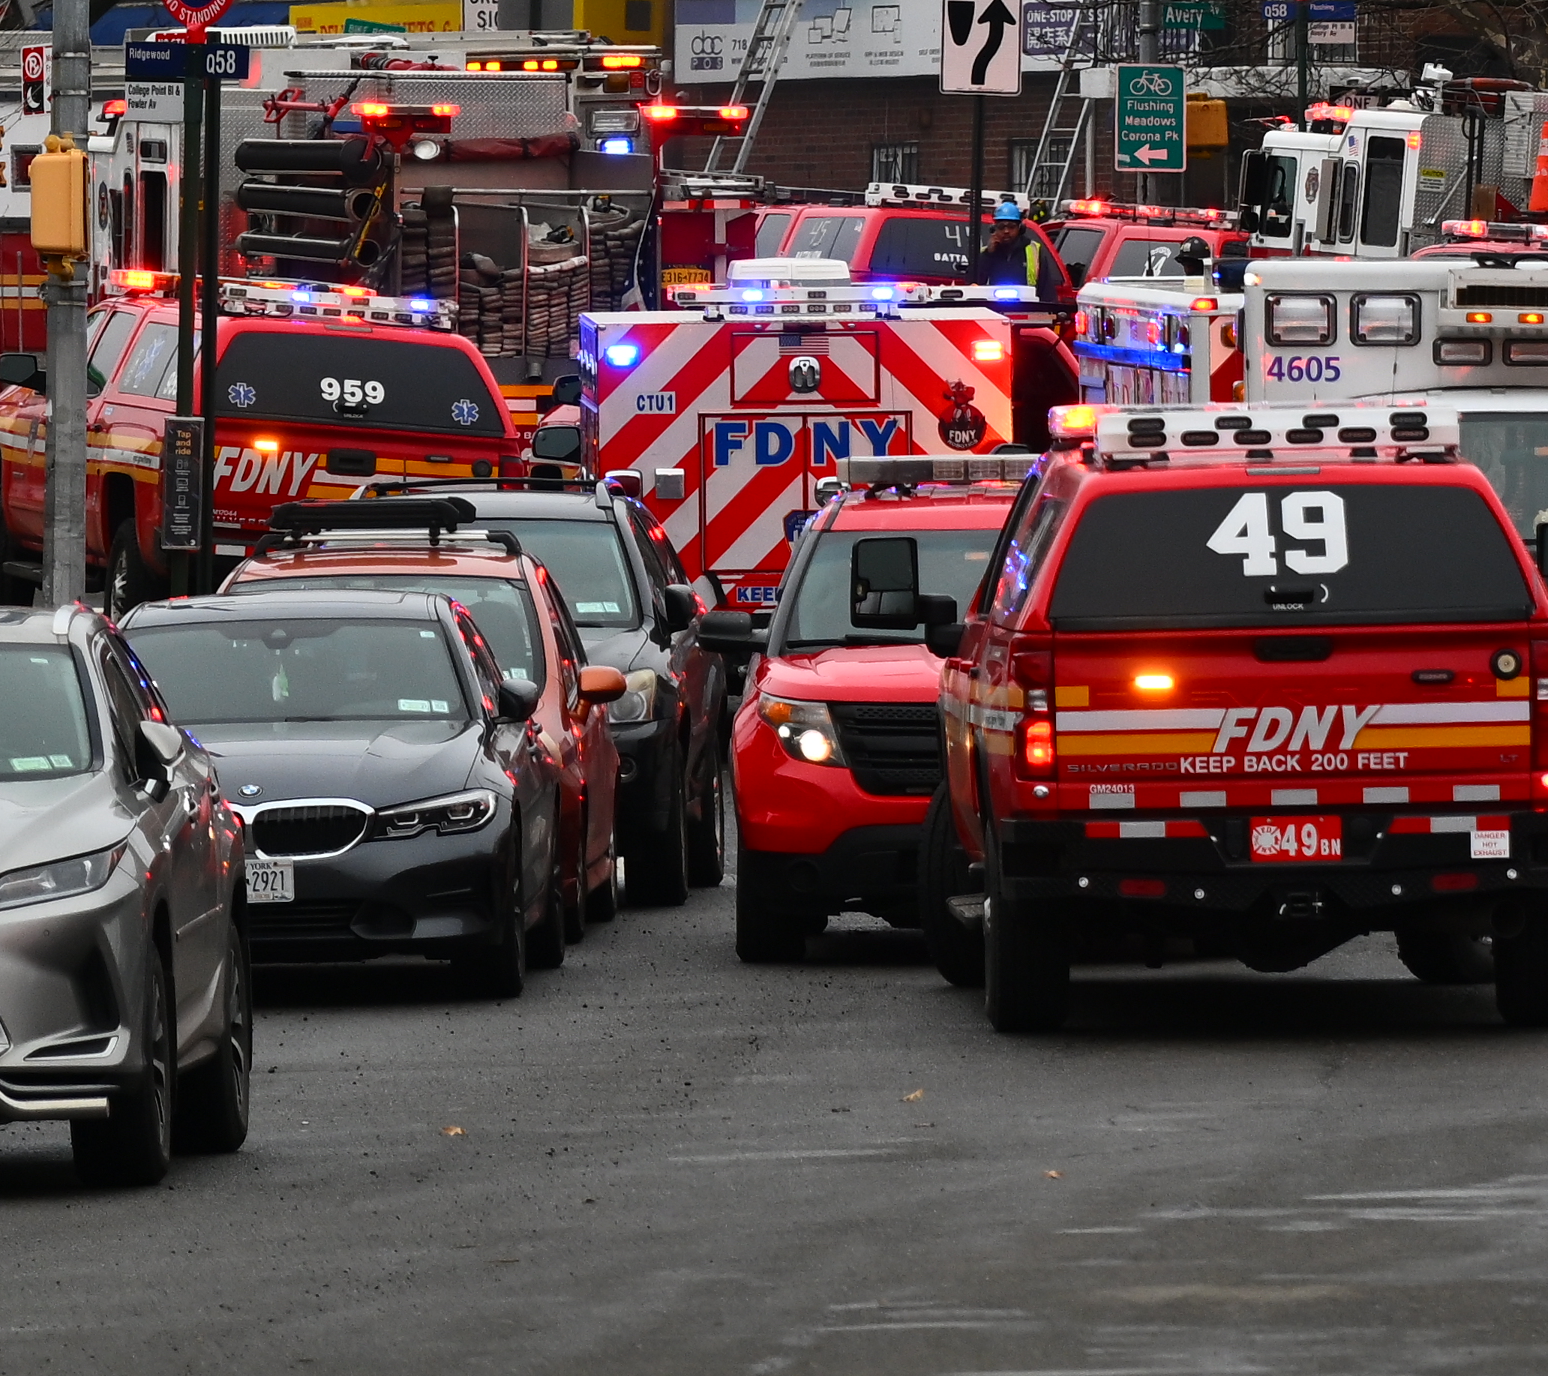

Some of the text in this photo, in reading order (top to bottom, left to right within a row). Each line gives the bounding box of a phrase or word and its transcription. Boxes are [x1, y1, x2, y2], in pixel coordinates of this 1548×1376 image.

[1026, 9, 1074, 23] ONE-STOP
[1165, 6, 1204, 26] Avery
[1264, 3, 1335, 19] Q58 Flushing
[129, 47, 237, 75] Ridgewood Q58
[127, 84, 150, 98] College
[151, 83, 168, 96] Point
[174, 84, 181, 96] &
[127, 98, 157, 111] Fowler Av
[1126, 99, 1174, 115] Flushing
[1124, 114, 1177, 127] Meadows
[1121, 129, 1180, 142] Corona Pk
[1266, 355, 1341, 383] 4605
[319, 376, 386, 405] 959
[636, 393, 675, 412] CTU1
[175, 439, 191, 447] and
[176, 430, 192, 440] Tap
[948, 429, 976, 444] FDNY
[174, 447, 192, 456] ride
[712, 418, 899, 469] FDNY
[213, 445, 320, 497] FDNY
[1205, 490, 1349, 577] 49
[1272, 603, 1304, 611] UNLOCK
[1211, 703, 1385, 753] FDNY
[1066, 762, 1180, 774] SILVERADO
[1180, 755, 1235, 774] KEEP
[1243, 753, 1302, 773] BACK
[1310, 753, 1349, 771] 200
[1357, 751, 1410, 770] FEET
[1088, 782, 1136, 794] GM24013
[1280, 822, 1342, 857] 49 BN
[250, 862, 273, 871] YORK
[251, 869, 285, 893] 2921
